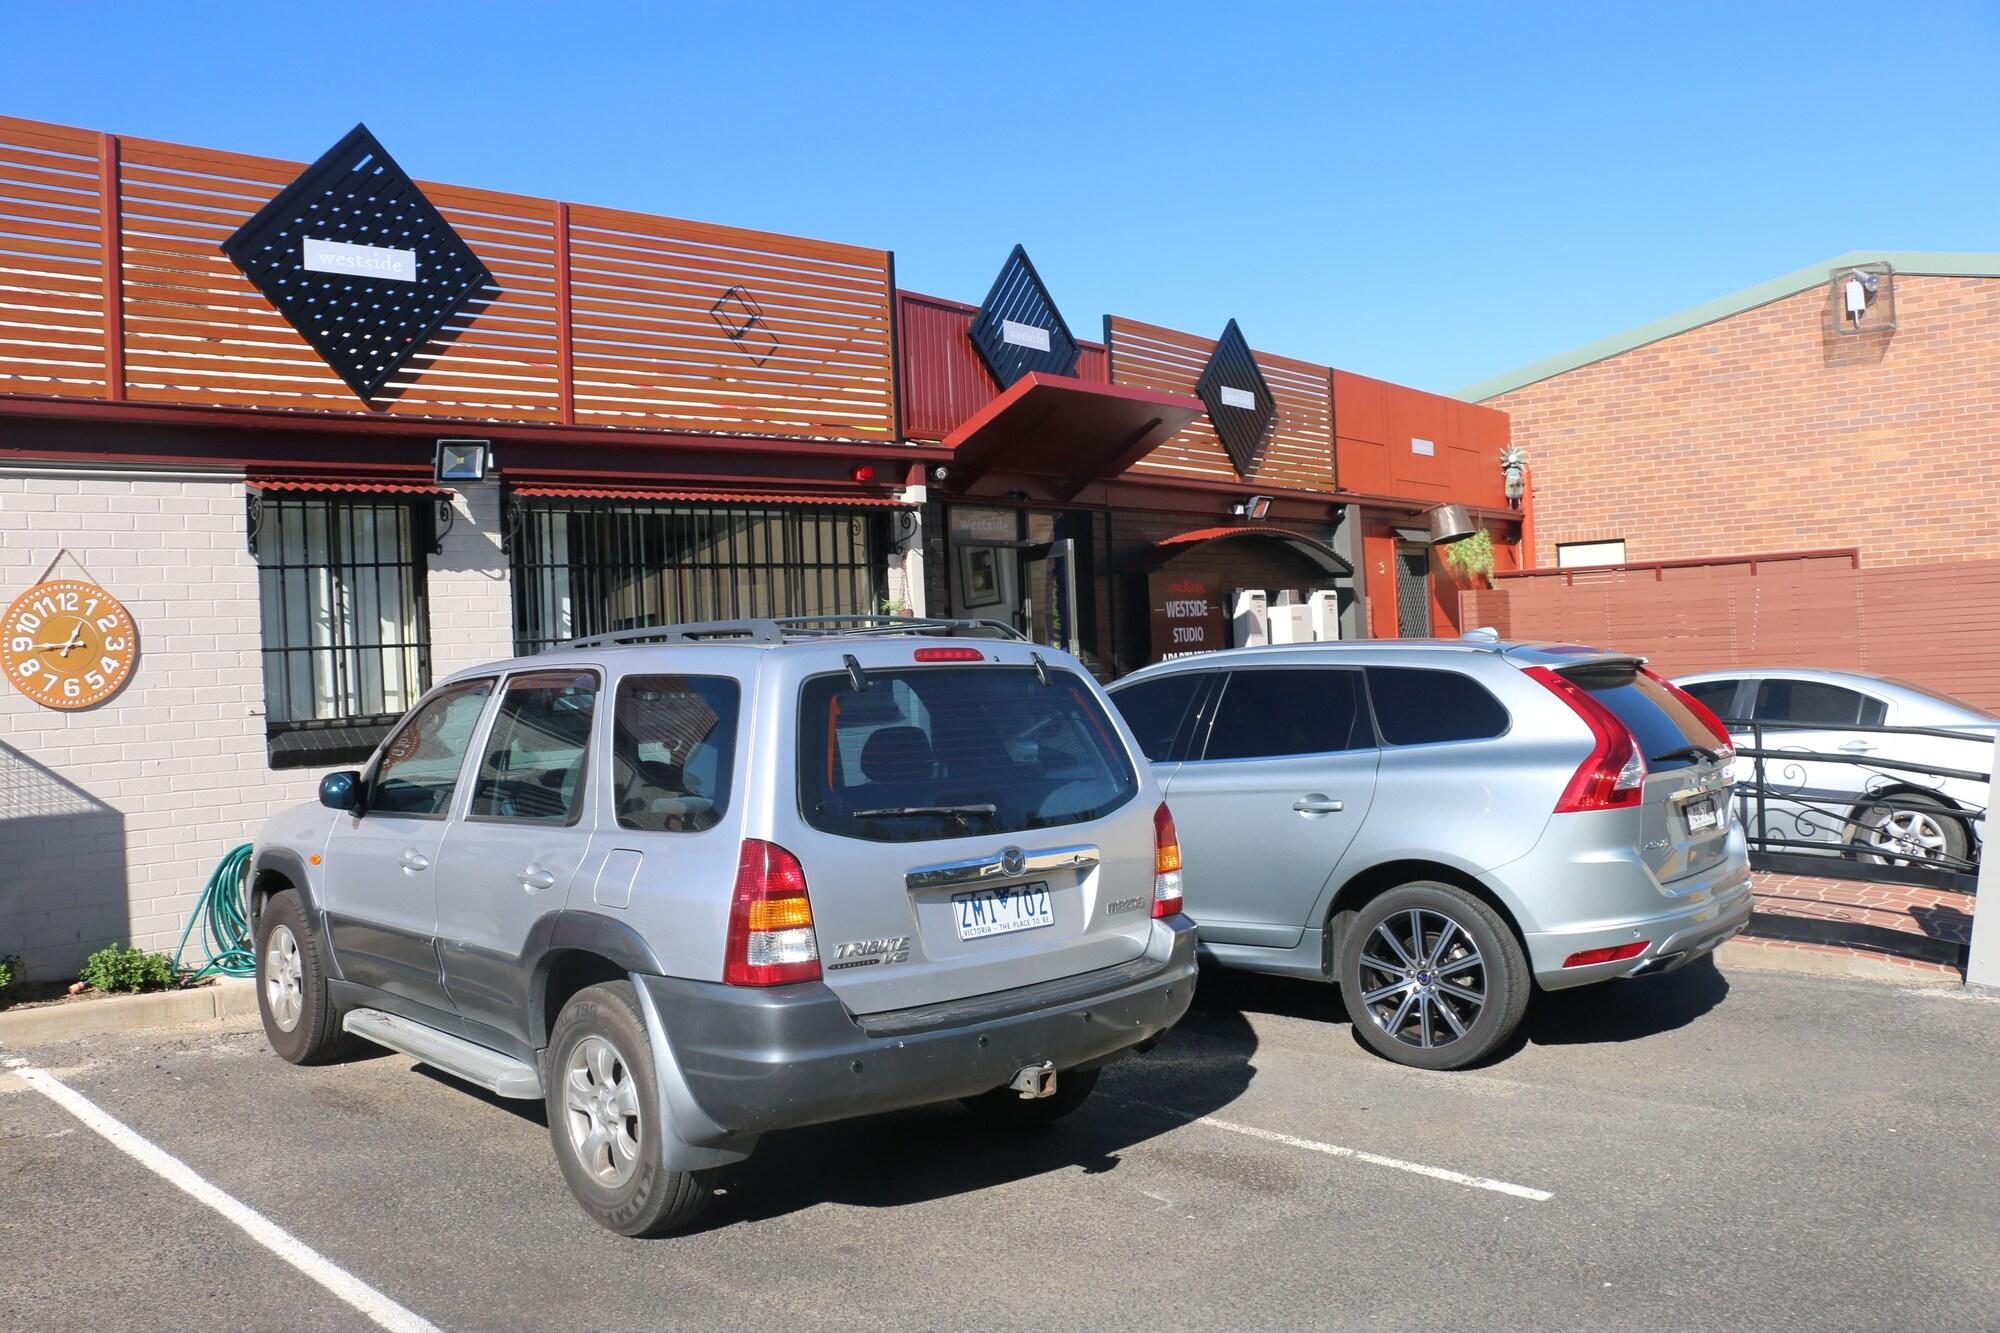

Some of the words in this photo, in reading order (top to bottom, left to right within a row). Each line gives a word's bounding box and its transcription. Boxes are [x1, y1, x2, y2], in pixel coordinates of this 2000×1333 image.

[318, 251, 404, 273] westside
[33, 596, 57, 618] 11
[55, 592, 79, 611] 12
[85, 598, 98, 616] 1
[1165, 600, 1209, 618] WESTSIDE
[16, 612, 41, 634] 10
[97, 614, 118, 633] 2
[12, 636, 33, 652] 9
[105, 636, 125, 651] 3
[1173, 626, 1204, 643] STUDIO
[18, 658, 40, 677] 8
[100, 656, 120, 674] 4
[43, 672, 58, 692] 7
[63, 678, 80, 697] 6
[84, 669, 105, 690] 5
[1010, 888, 1048, 919] 702
[963, 926, 992, 937] VICTORIA
[1000, 923, 1010, 931] THE
[1013, 920, 1031, 928] PLACE
[833, 937, 910, 959] TRIBUTE
